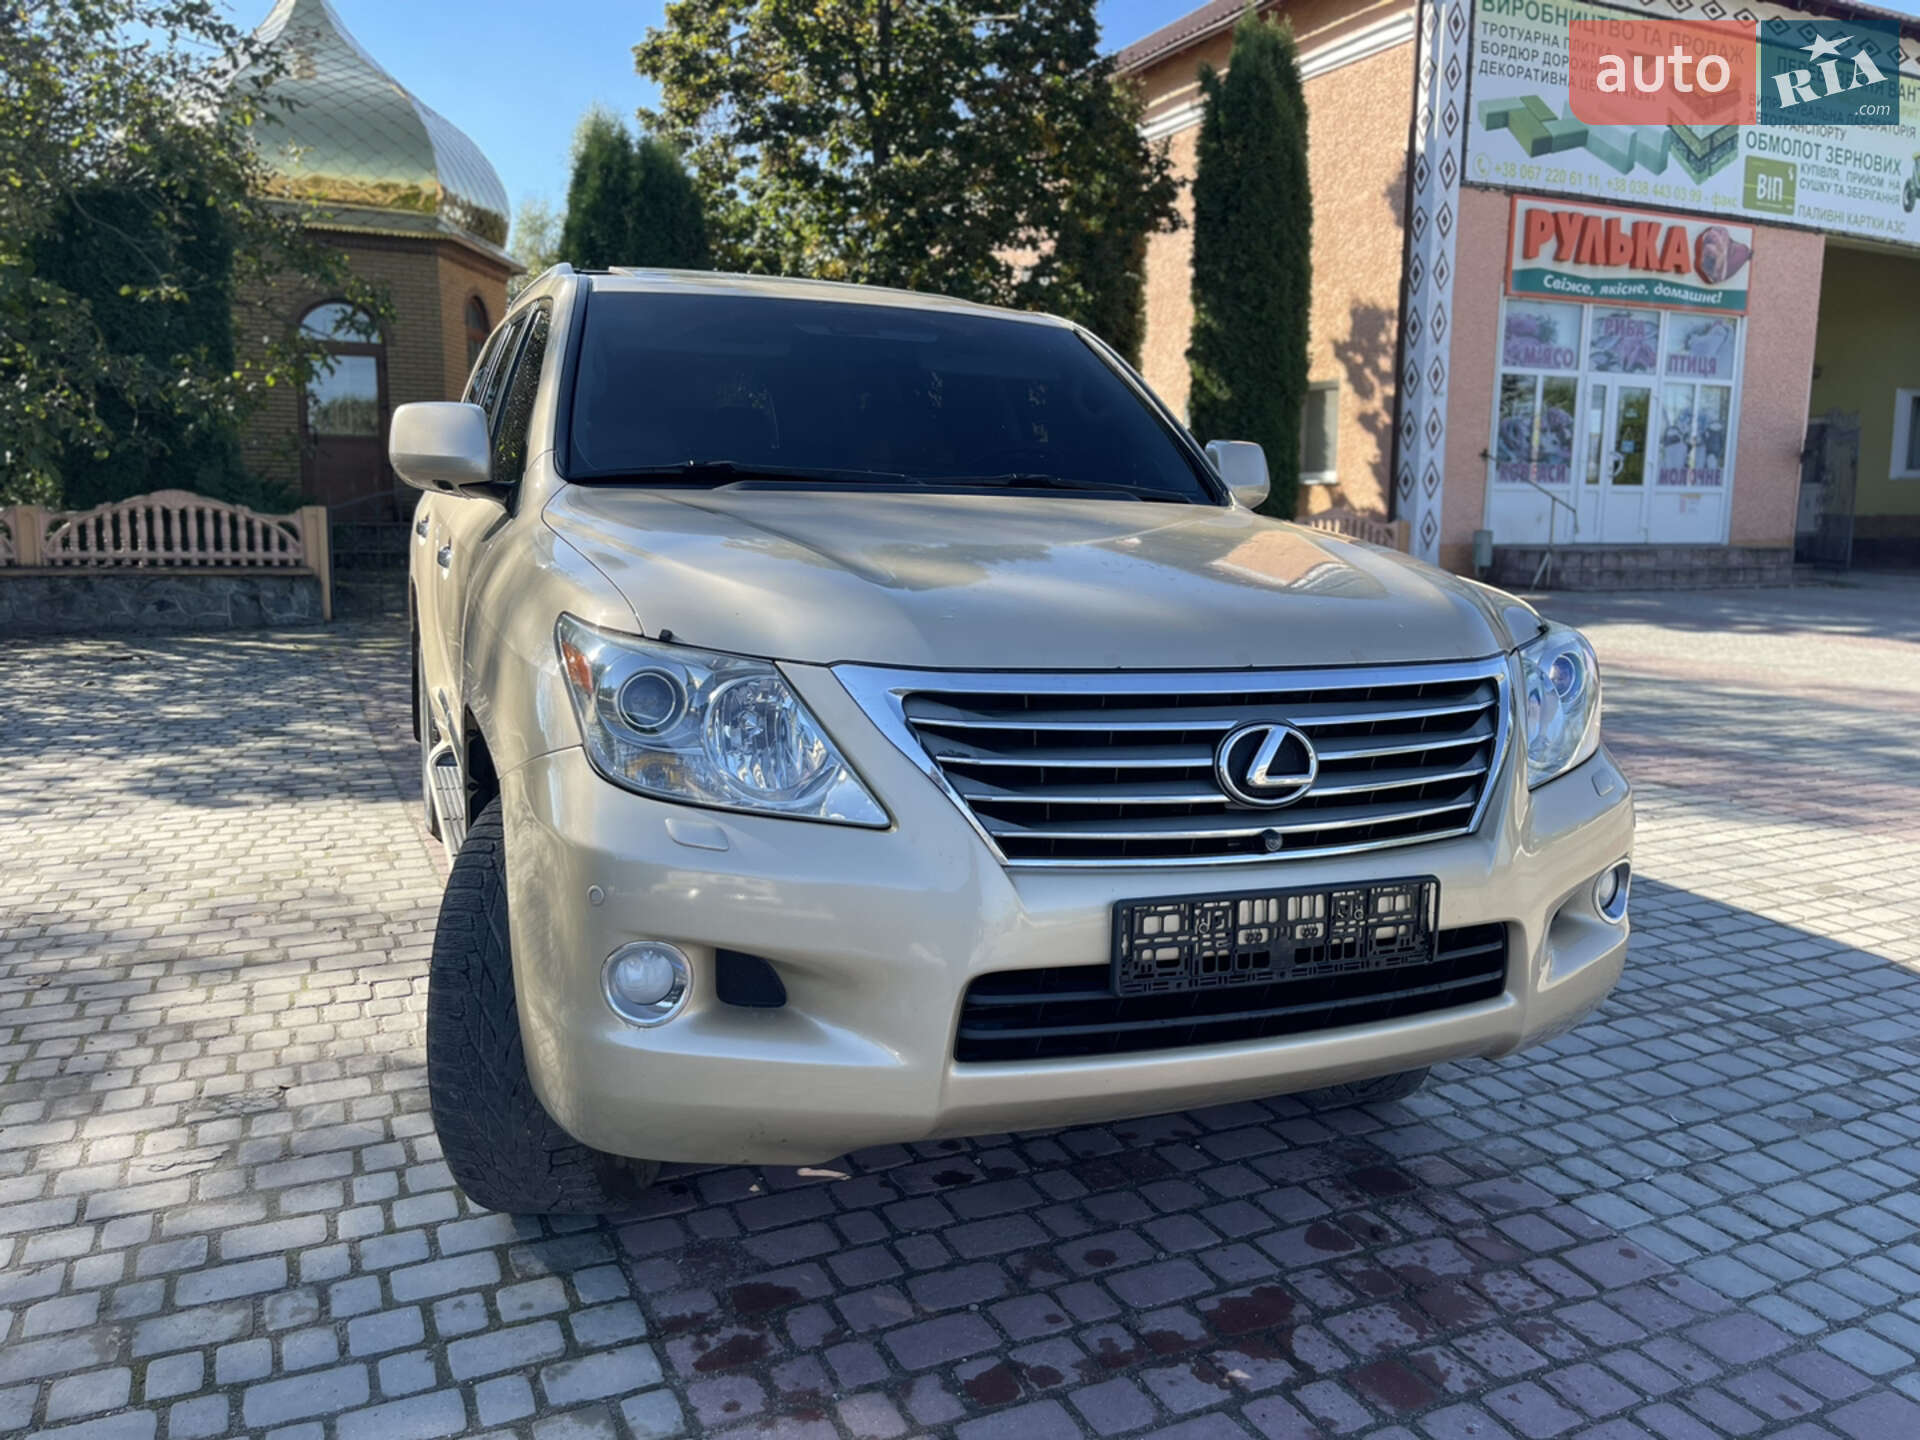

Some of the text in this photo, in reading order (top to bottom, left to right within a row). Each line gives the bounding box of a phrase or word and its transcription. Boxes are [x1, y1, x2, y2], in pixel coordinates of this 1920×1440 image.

[1481, 0, 1745, 64] ВИРОБНИЦТВО ТА ПРОДАЖ
[1481, 21, 1560, 48] ТРОТУАРНА
[1480, 40, 1540, 63] БОРДЮР
[1478, 59, 1577, 88] ДЕКОРАТИВНА
[1745, 130, 1902, 177] ОБМОЛОТ ЗЕРНОВИХ
[1494, 161, 1517, 178] +38
[1545, 167, 1566, 184] 220
[1569, 170, 1583, 186] 61
[1607, 177, 1627, 194] +38
[1652, 183, 1672, 199] 443
[1755, 173, 1784, 202] ВІП
[1799, 176, 1901, 205] СУШКУ ТА ЗБЕРІГАННЯ
[1846, 170, 1885, 188] ПРИЙОМ
[1888, 178, 1901, 192] НА
[1798, 204, 1844, 223] ПАЛИВНІ
[1847, 212, 1885, 230] КАРТКИ
[1886, 218, 1906, 235] АЗС
[1523, 207, 1692, 275] РУЛЬКА
[1543, 274, 1594, 297] Свіже,
[1604, 317, 1646, 338] РИБА
[1668, 353, 1718, 377] ПТИЦЯ
